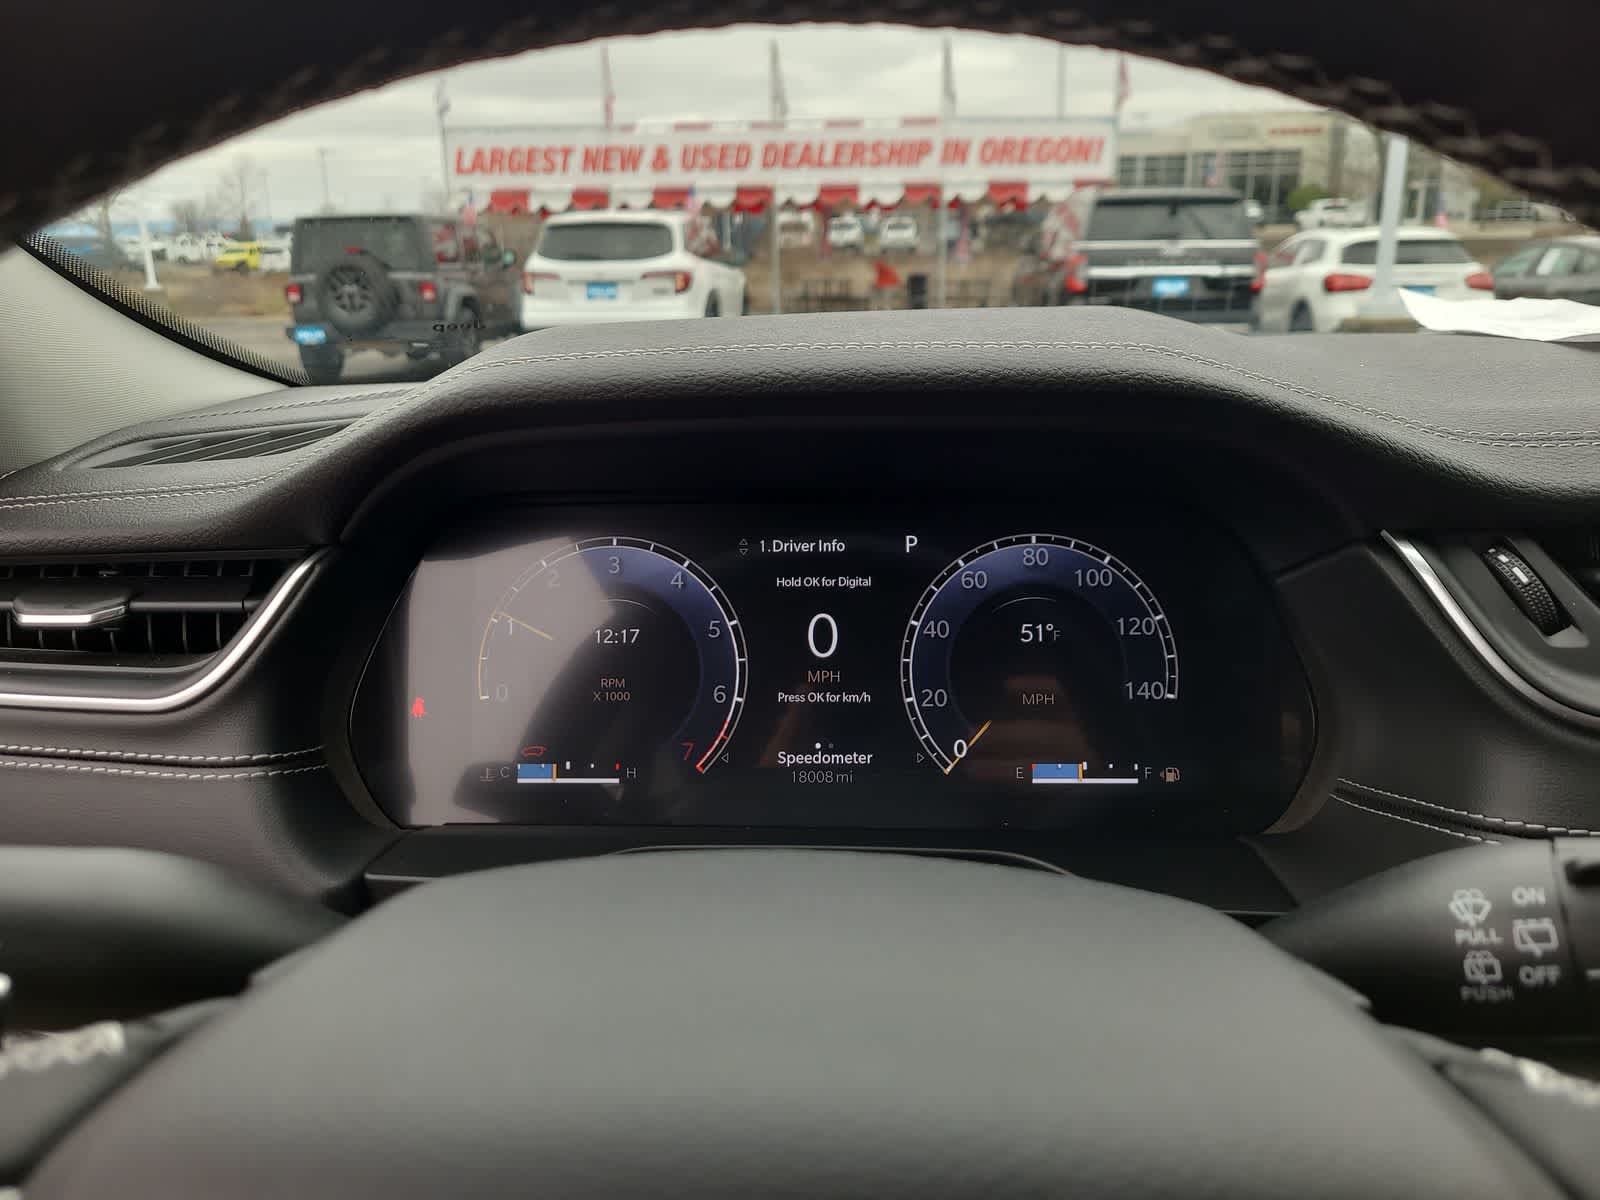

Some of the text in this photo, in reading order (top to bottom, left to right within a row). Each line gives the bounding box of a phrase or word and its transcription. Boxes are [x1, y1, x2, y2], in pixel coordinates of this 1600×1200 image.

[456, 136, 1105, 175] LARGEST NEW & USED DEALERSHIP IN OREGON!
[819, 539, 846, 553] Info
[905, 535, 918, 553] P
[609, 556, 620, 574] 3
[1022, 547, 1049, 566] 80
[549, 570, 561, 588] 2
[670, 572, 684, 590] 4
[776, 576, 872, 589] Hold OK for Digital
[960, 570, 988, 589] 60
[1074, 568, 1113, 587] 100
[506, 618, 513, 636] 1
[708, 620, 721, 638] 5
[923, 620, 950, 639] 40
[1116, 617, 1155, 636] 120
[594, 628, 640, 645] 12:17
[807, 613, 839, 659] 0
[600, 677, 626, 689] RPM
[807, 670, 841, 683] MPH
[496, 684, 508, 701] 0
[593, 691, 631, 702] X 1000
[713, 685, 726, 704] 6
[778, 691, 871, 704] Press OK for km/h
[921, 688, 948, 708] 20
[1022, 693, 1055, 705] MPH
[1125, 681, 1165, 701] 140
[682, 742, 695, 760] 7
[953, 739, 967, 758] 0
[777, 750, 873, 766] Speedometer
[500, 766, 510, 778] C
[626, 768, 637, 779] H
[791, 770, 853, 783] 18008 mi
[1015, 767, 1024, 779] E
[1144, 767, 1152, 779] F
[1511, 886, 1547, 906] ON
[1454, 928, 1504, 945] PULL
[1519, 965, 1561, 985] OFF
[1461, 985, 1514, 1002] PUSH
